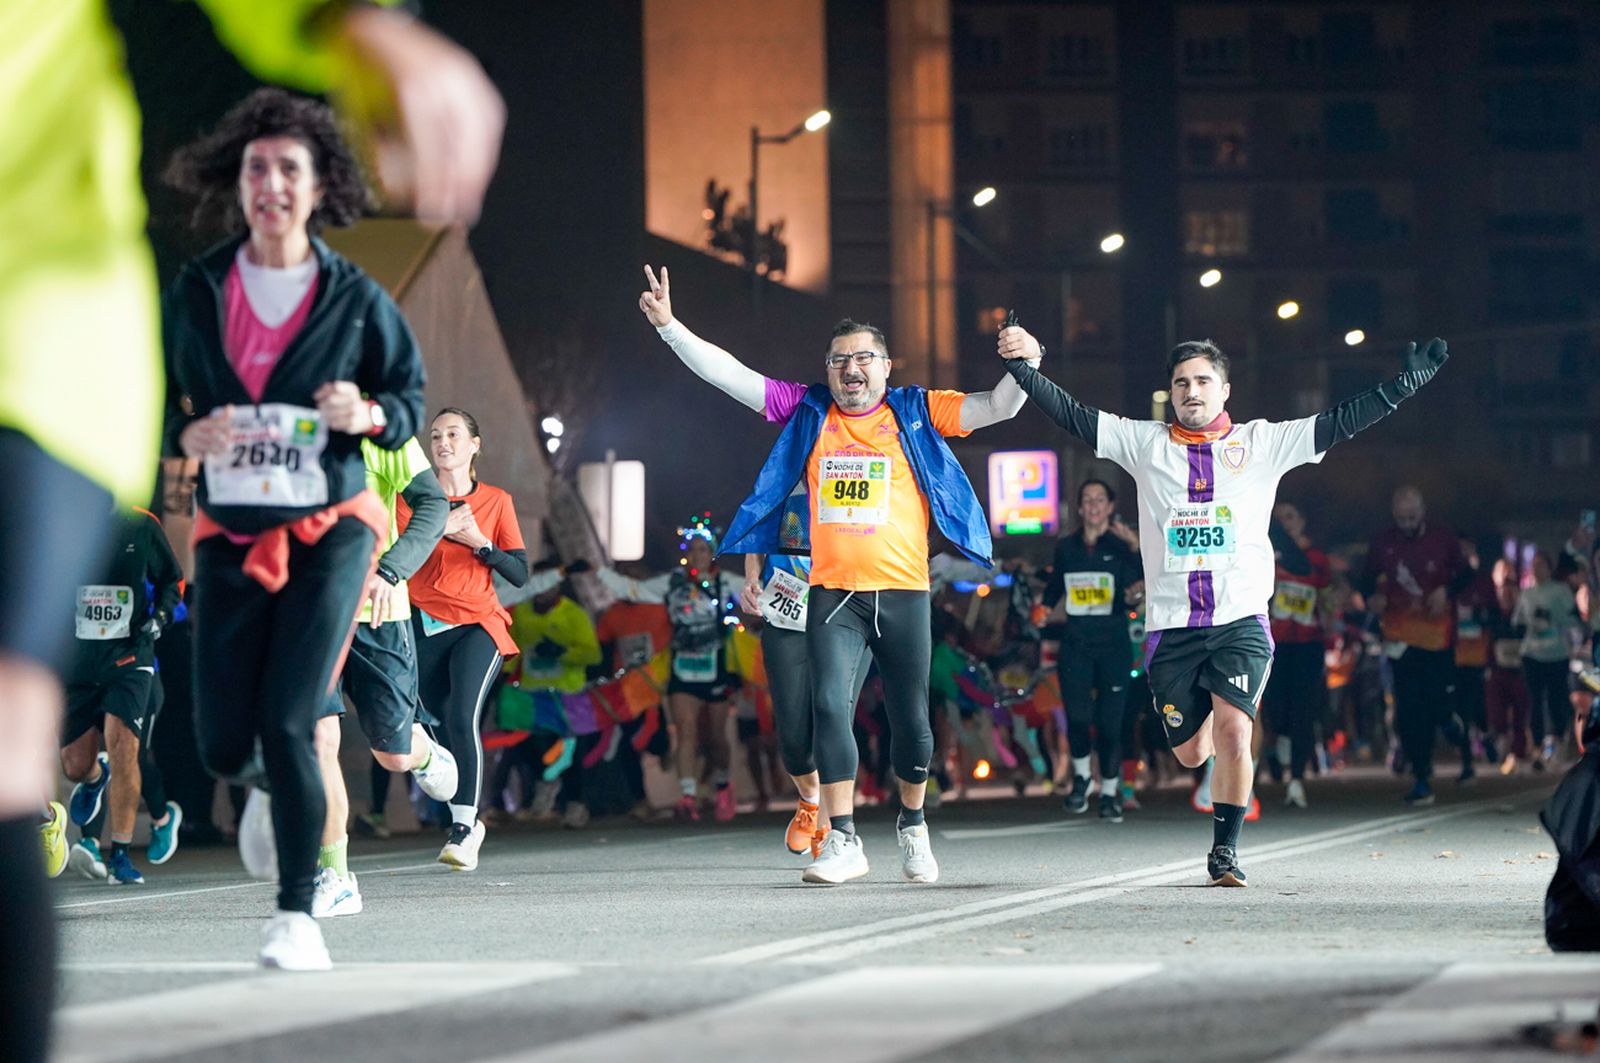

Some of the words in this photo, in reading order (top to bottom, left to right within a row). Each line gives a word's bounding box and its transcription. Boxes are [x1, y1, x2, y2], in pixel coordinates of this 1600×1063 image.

[834, 480, 869, 500] 948
[1171, 519, 1184, 527] SAN
[1176, 526, 1224, 548] 3253
[85, 605, 122, 621] 4963
[769, 592, 803, 621] 2155
